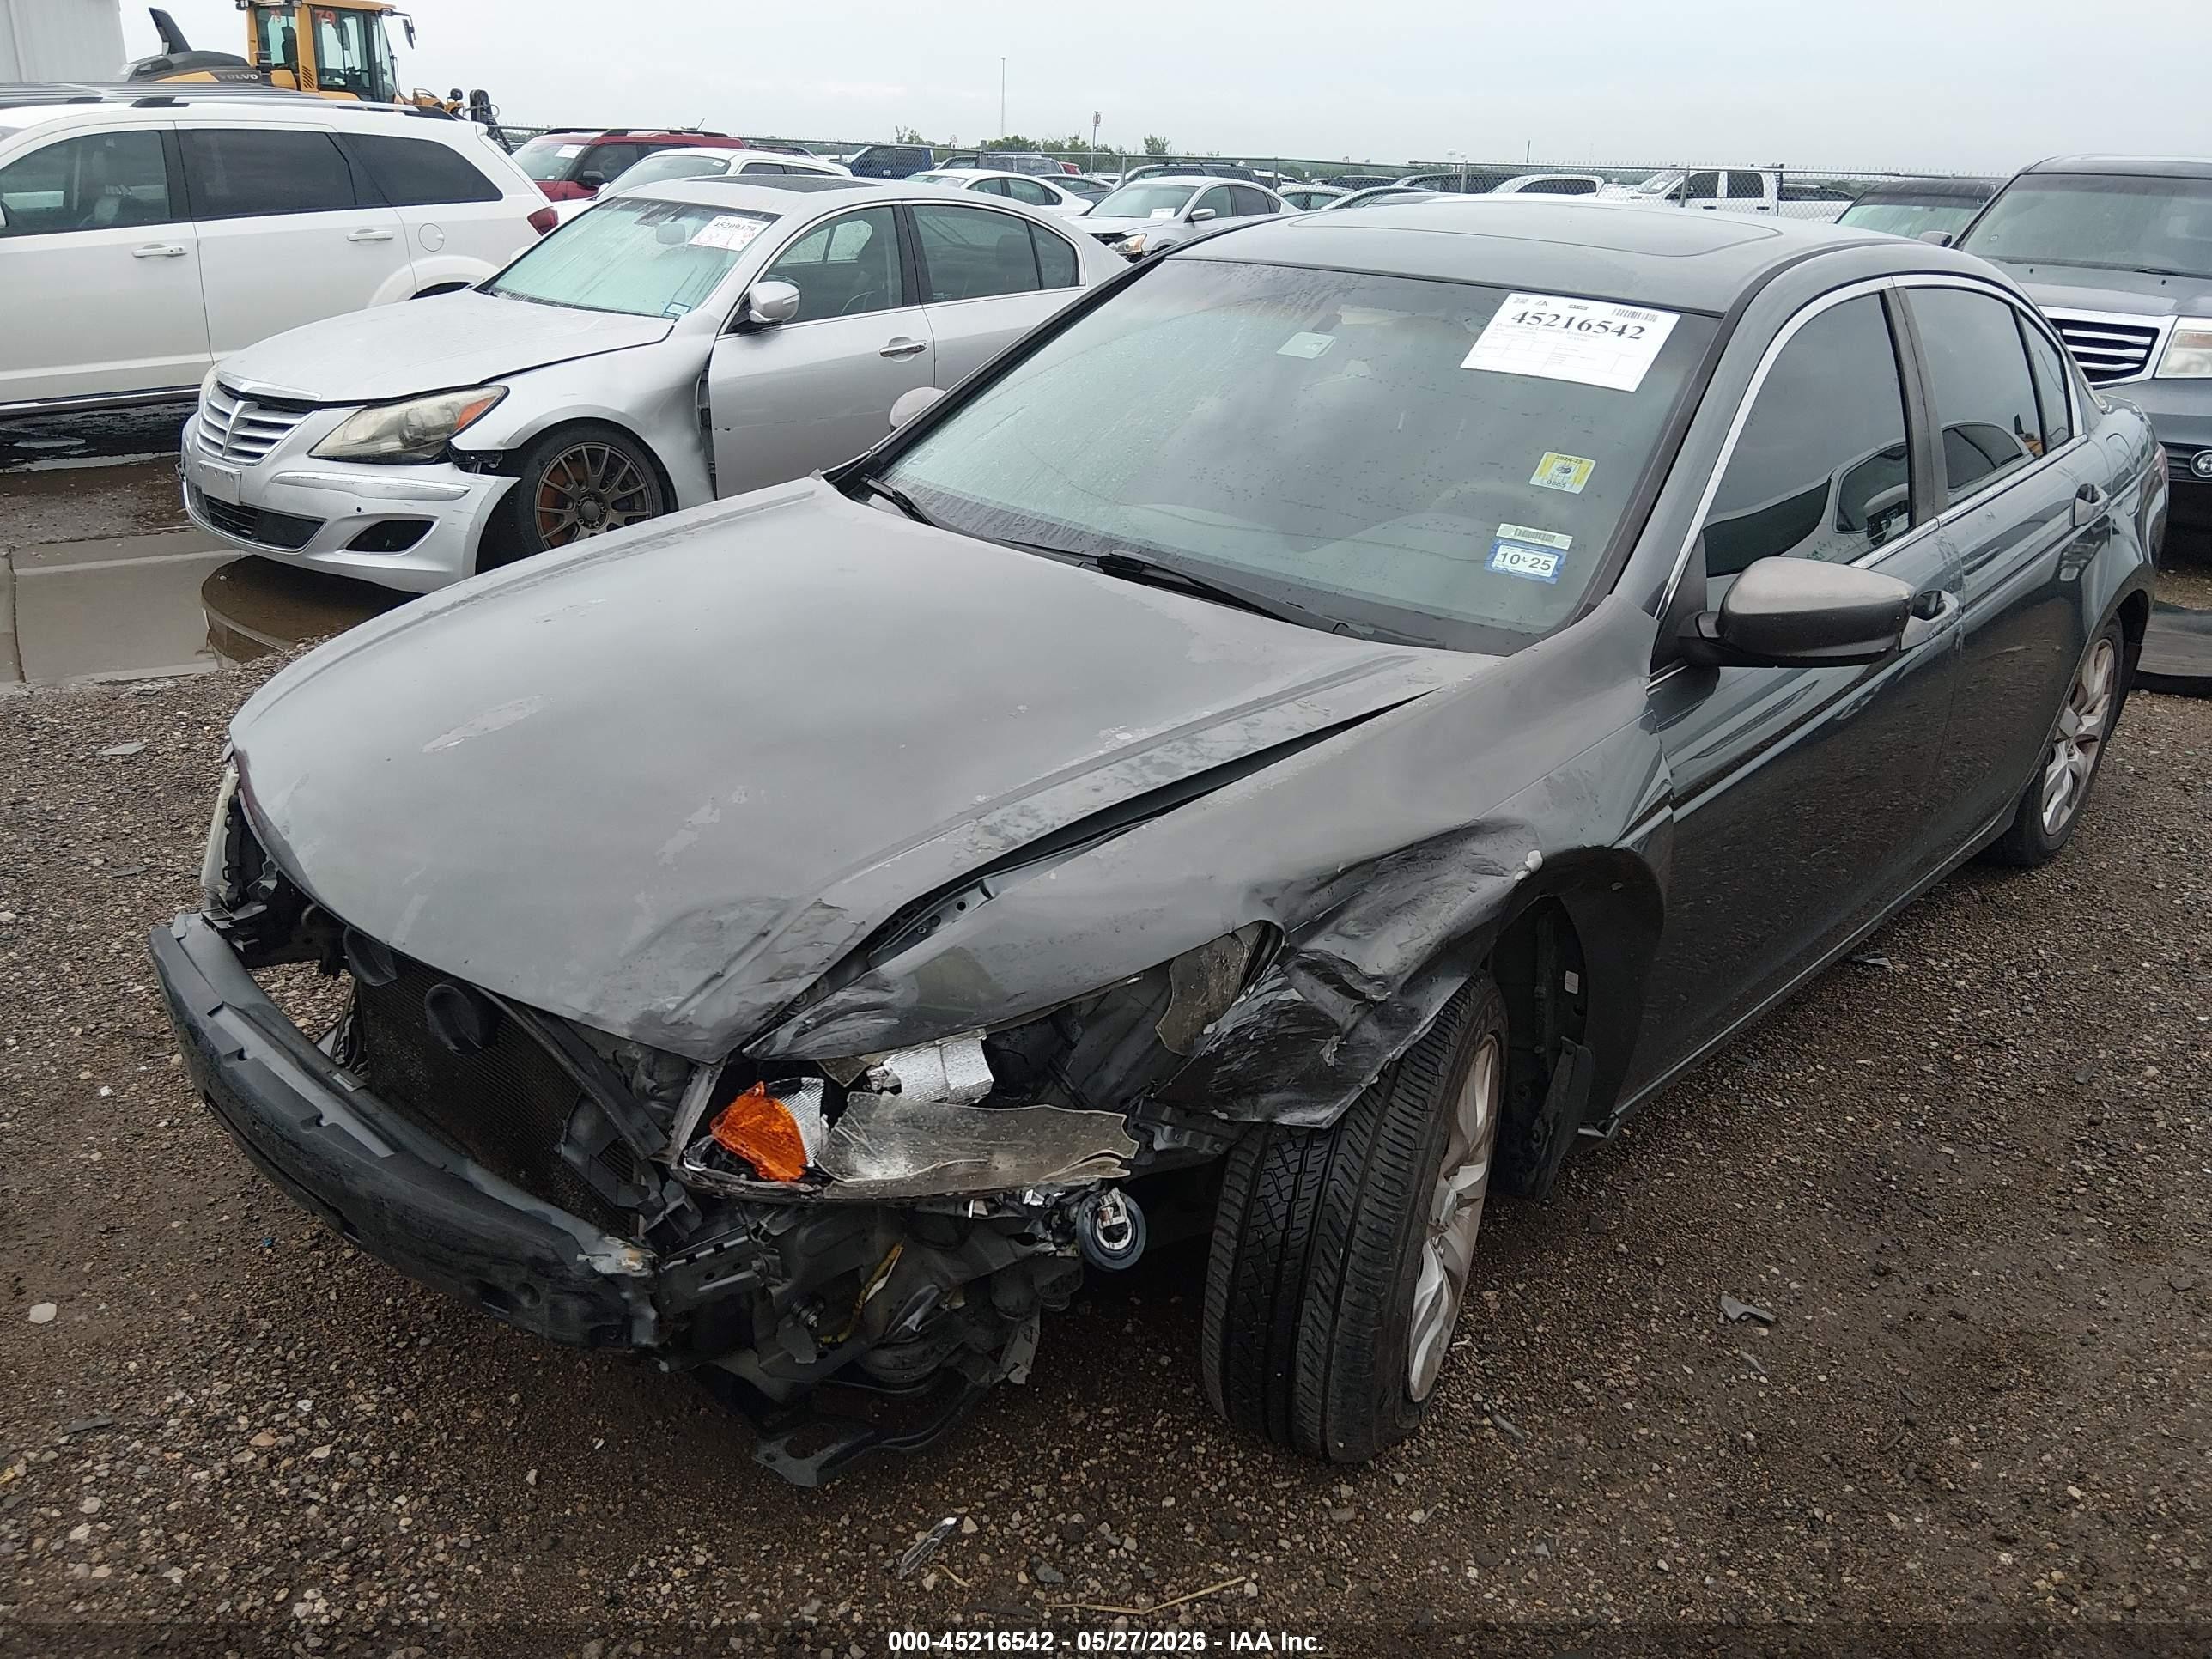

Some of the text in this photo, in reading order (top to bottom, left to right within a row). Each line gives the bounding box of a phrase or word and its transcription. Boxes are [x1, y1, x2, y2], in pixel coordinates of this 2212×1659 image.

[1510, 310, 1646, 341] 45216542
[1500, 552, 1521, 565] 10
[1528, 557, 1553, 572] 25
